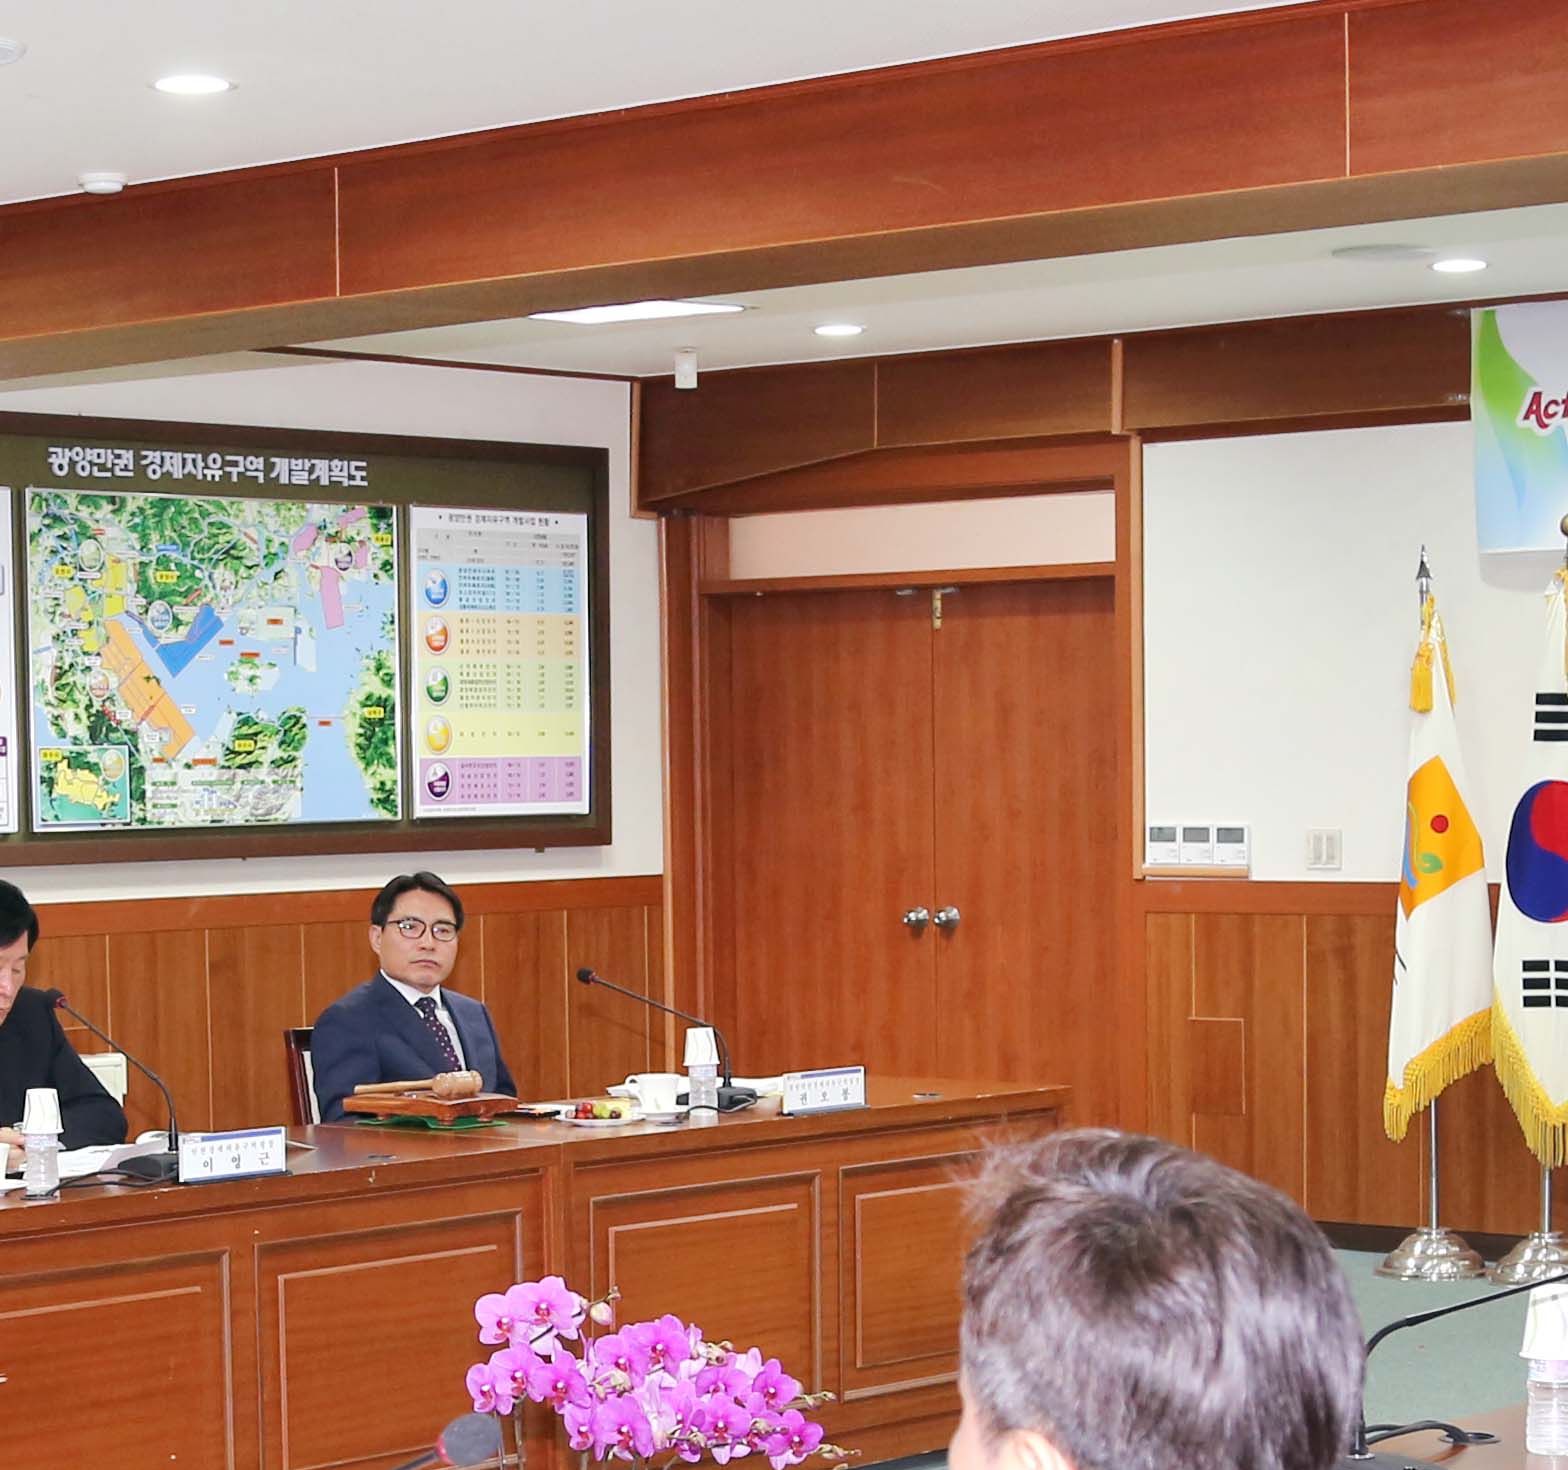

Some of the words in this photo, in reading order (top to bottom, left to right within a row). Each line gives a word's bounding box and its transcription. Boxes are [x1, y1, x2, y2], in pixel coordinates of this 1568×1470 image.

[47, 446, 135, 478] 광양만권
[140, 450, 265, 484] 경제자유구역
[269, 456, 369, 488] 개발계획도
